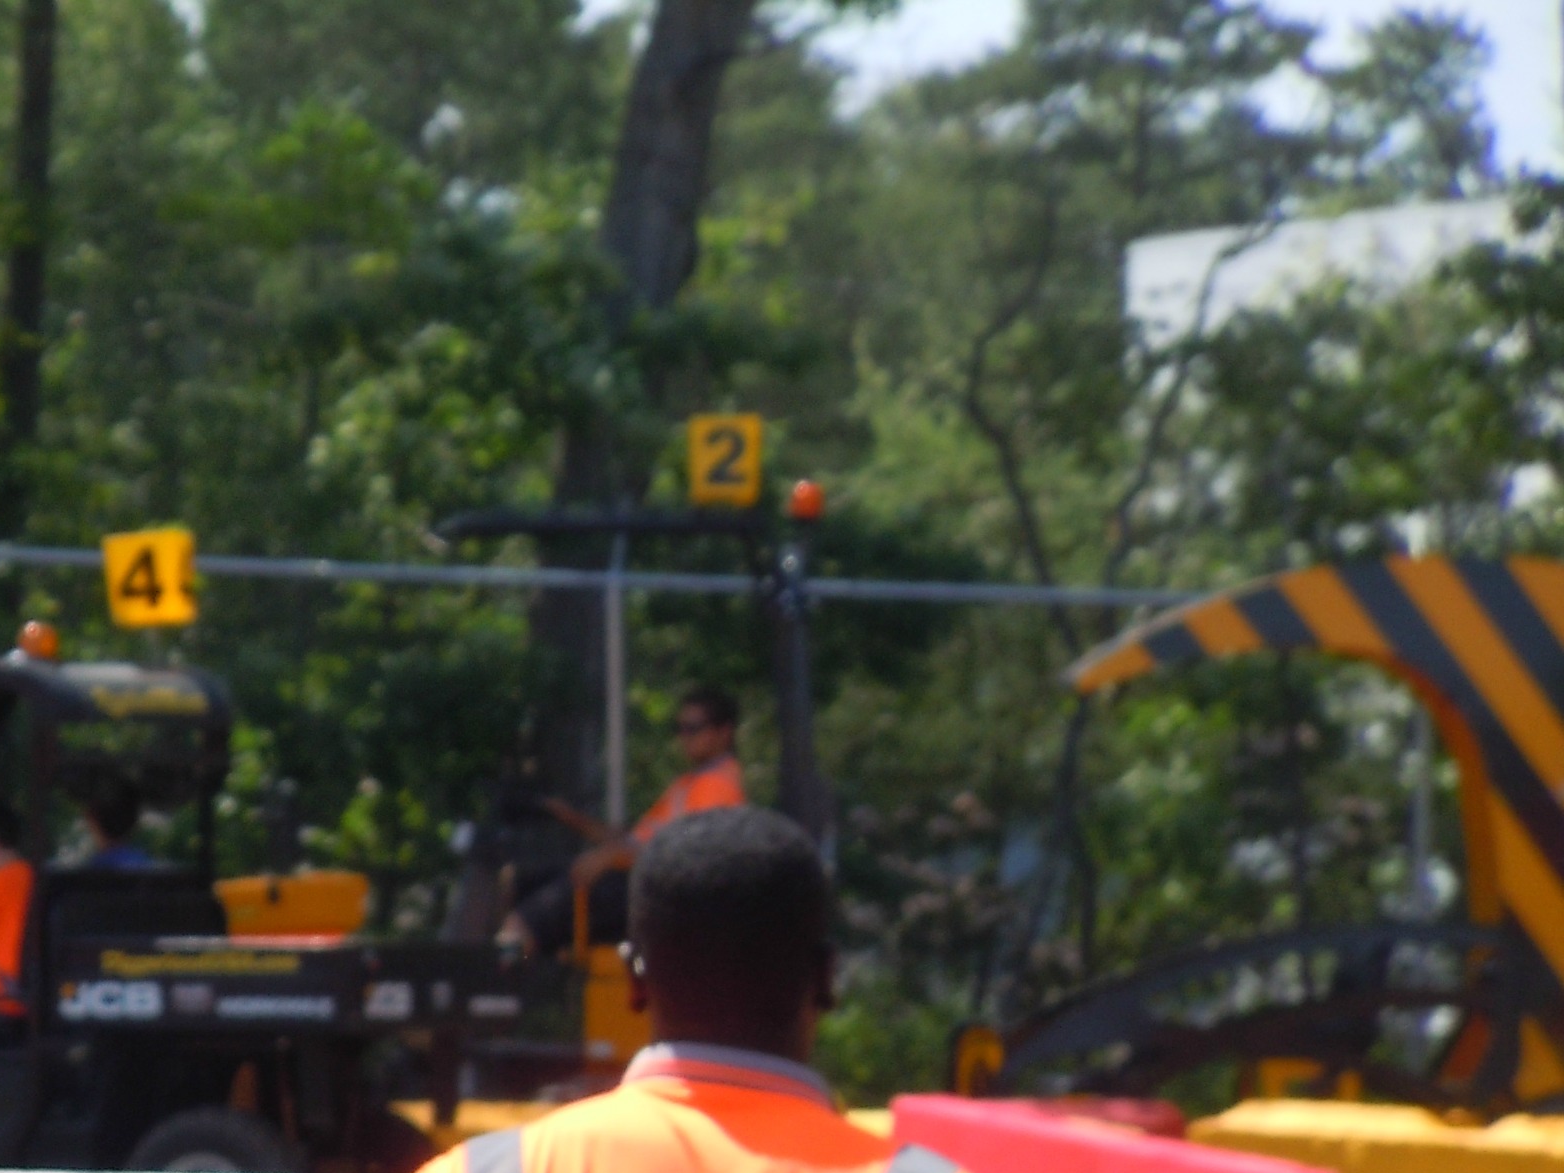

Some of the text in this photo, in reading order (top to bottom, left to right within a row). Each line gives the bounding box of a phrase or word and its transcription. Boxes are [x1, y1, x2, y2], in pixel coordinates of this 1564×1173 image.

[706, 427, 746, 484] 2
[120, 547, 162, 607] 4
[60, 980, 162, 1018] JCB
